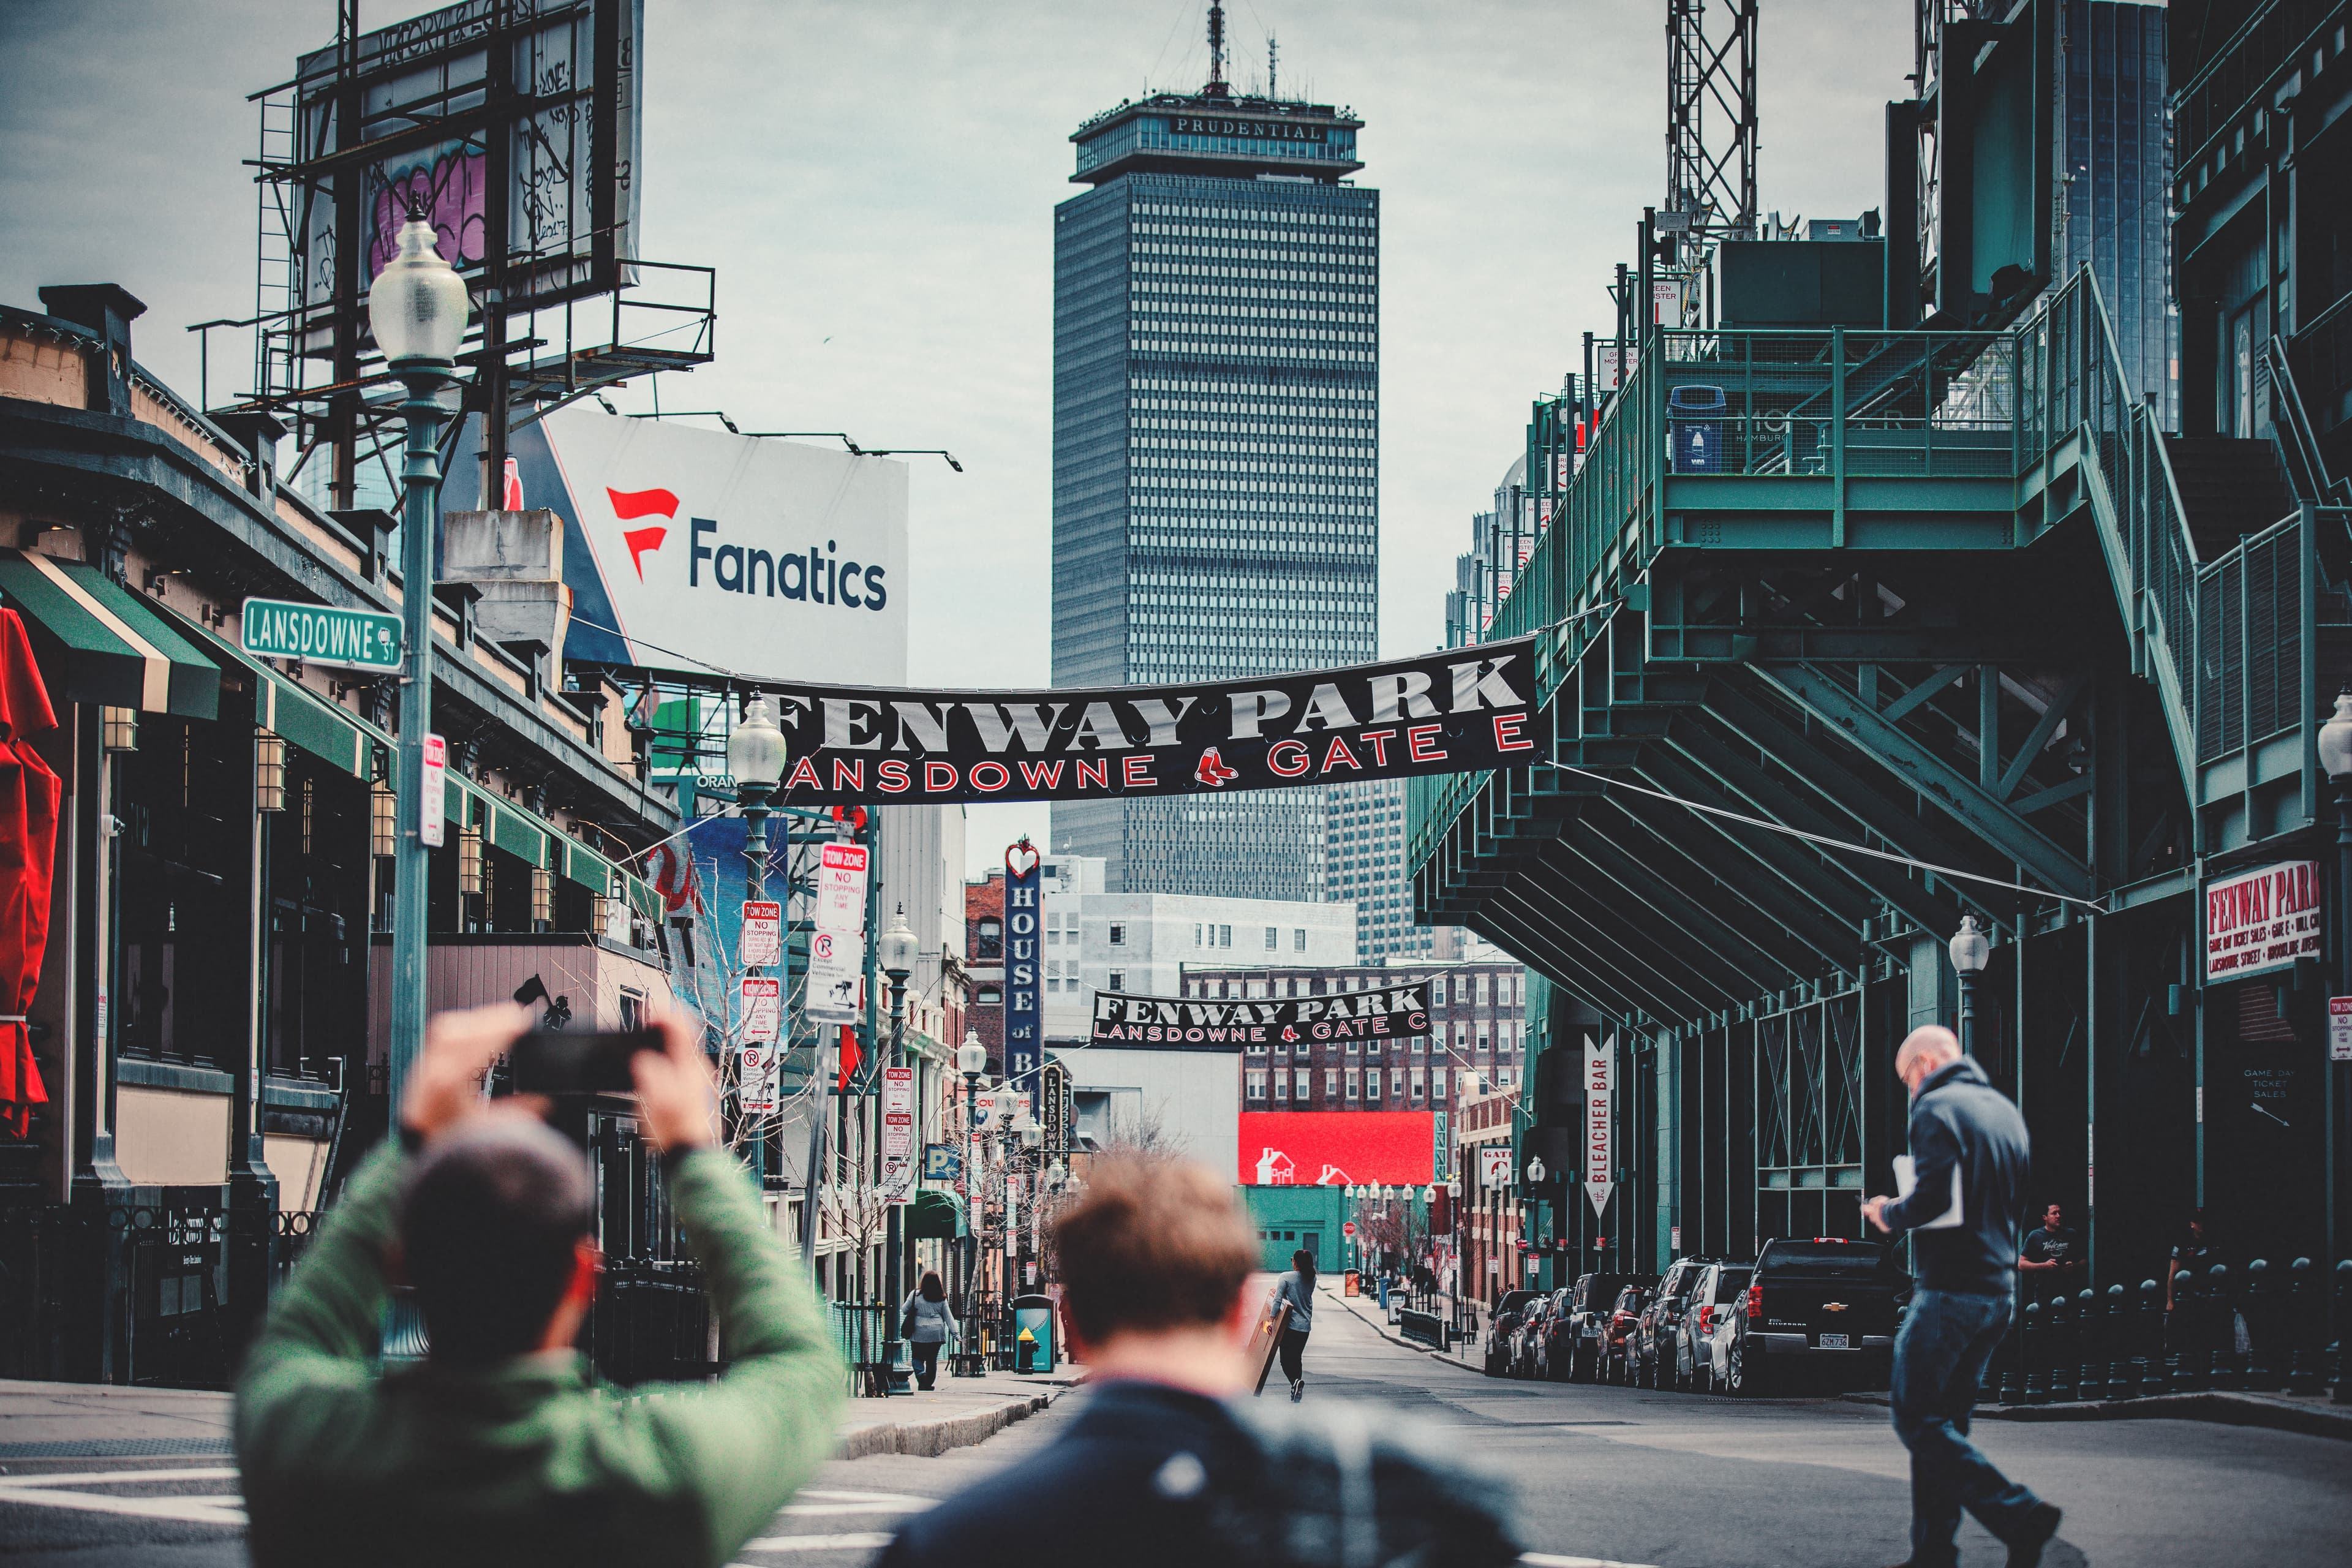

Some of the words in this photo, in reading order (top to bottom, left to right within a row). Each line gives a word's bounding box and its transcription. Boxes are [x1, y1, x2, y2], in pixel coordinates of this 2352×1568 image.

[1176, 118, 1321, 140] PRUDENTIAL
[541, 219, 568, 240] 2017
[690, 517, 887, 612] Fanatics
[249, 607, 374, 659] LANSDOWNE
[383, 641, 396, 662] ST
[750, 692, 1198, 753] FENWAY
[1226, 655, 1526, 740] PARK
[777, 754, 1158, 793] ANSDOWNE
[1267, 723, 1448, 777] GATE
[1492, 712, 1533, 753] E
[431, 770, 438, 782] NO
[827, 850, 843, 865] TOW
[843, 852, 864, 868] ZONE
[835, 872, 851, 883] NO
[824, 884, 861, 894] STOPPING
[2209, 874, 2272, 935] FENWAY
[2275, 860, 2320, 918] PARK
[761, 907, 777, 917] ZONE
[755, 921, 768, 929] NO
[2250, 925, 2266, 944] SALES
[2285, 920, 2290, 936] E
[1011, 886, 1035, 1011] HOUSE
[2241, 948, 2261, 967] STREET
[812, 963, 846, 972] Commercial
[1096, 995, 1285, 1026] FENWAY
[1295, 988, 1423, 1023] PARK
[2331, 1003, 2341, 1012] TOW
[2342, 1003, 2352, 1012] ZONE
[1011, 1023, 1032, 1039] of
[1093, 1021, 1267, 1042] LANSDOWNE
[1312, 1016, 1390, 1038] GATE
[1409, 1012, 1427, 1030] C
[2337, 1016, 2348, 1025] NO
[1592, 1060, 1607, 1090] BAR
[1592, 1099, 1607, 1183] BLEACHER
[1596, 1186, 1604, 1203] the
